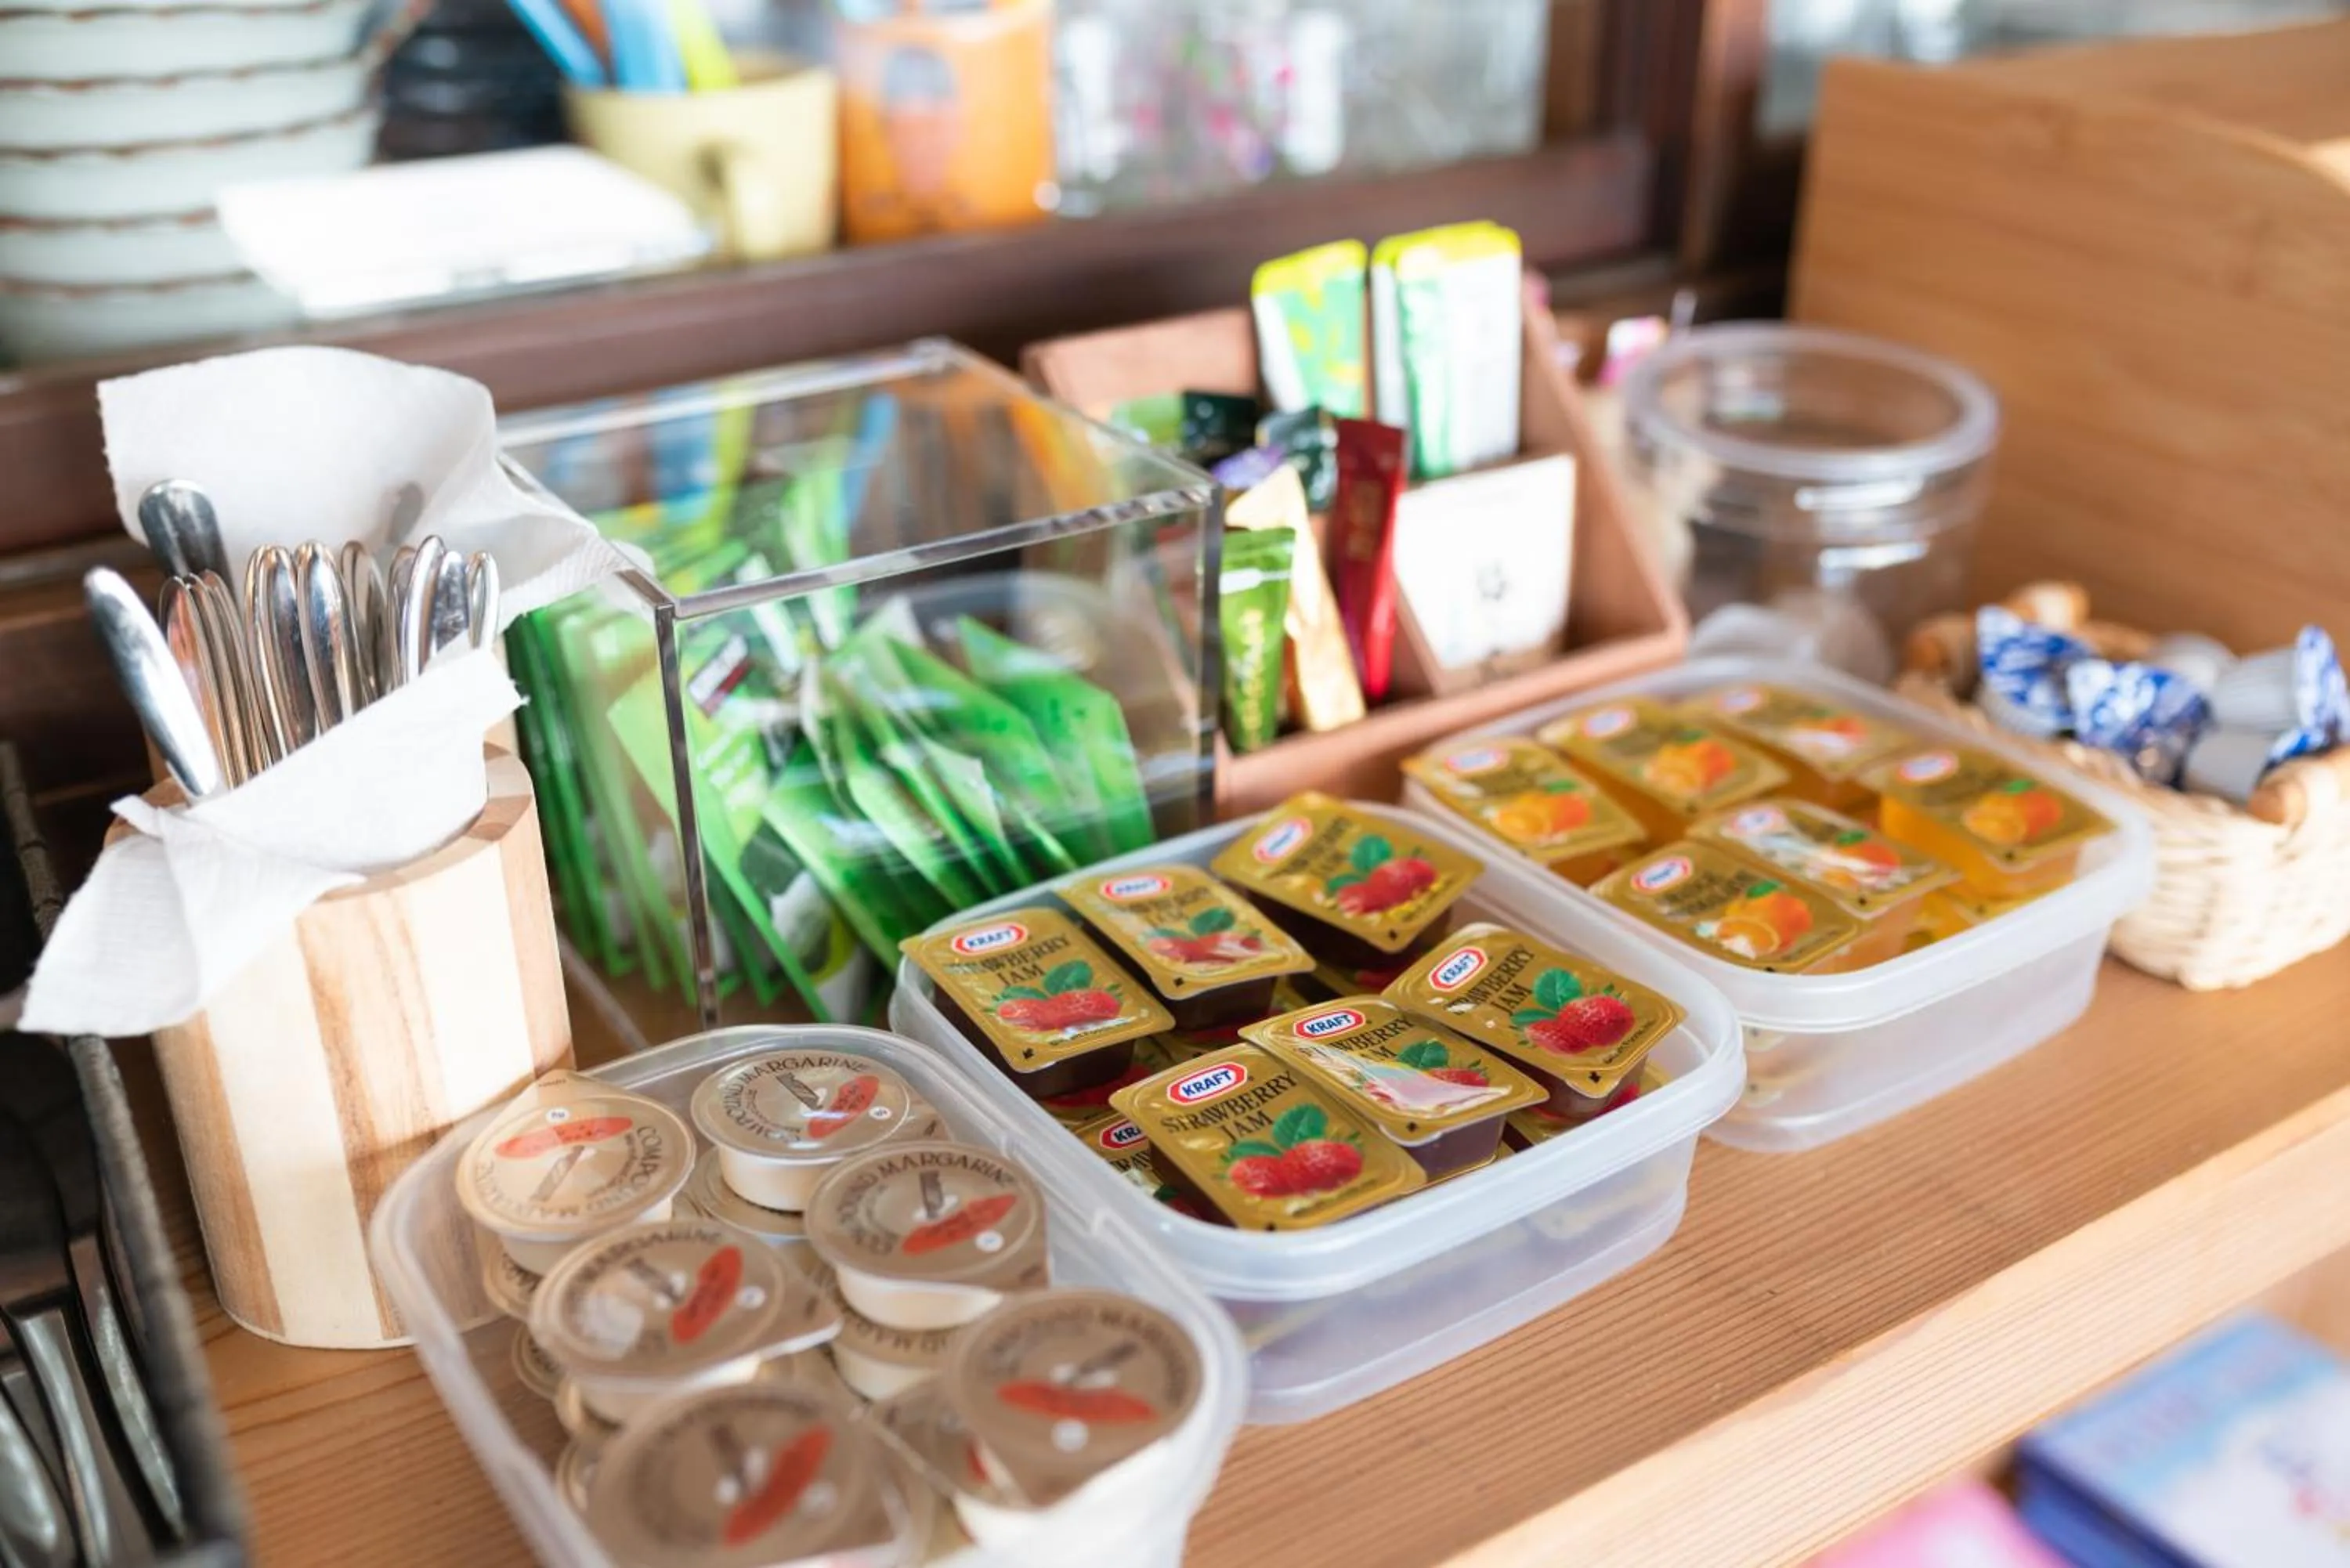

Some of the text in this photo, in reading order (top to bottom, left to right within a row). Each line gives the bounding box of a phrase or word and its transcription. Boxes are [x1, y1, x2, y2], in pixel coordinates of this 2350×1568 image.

[967, 930, 1012, 949] KRAFT
[996, 963, 1047, 987] JAM
[1441, 953, 1476, 983] KRAFT
[1490, 981, 1533, 1016] JAM
[1305, 1013, 1352, 1034] KRAFT
[741, 1056, 868, 1086] MARGARINE
[1181, 1069, 1233, 1097] KRAFT
[1160, 1070, 1298, 1133] STRAWBERRY
[1113, 1125, 1142, 1142] KRA
[1219, 1109, 1275, 1146] JAM
